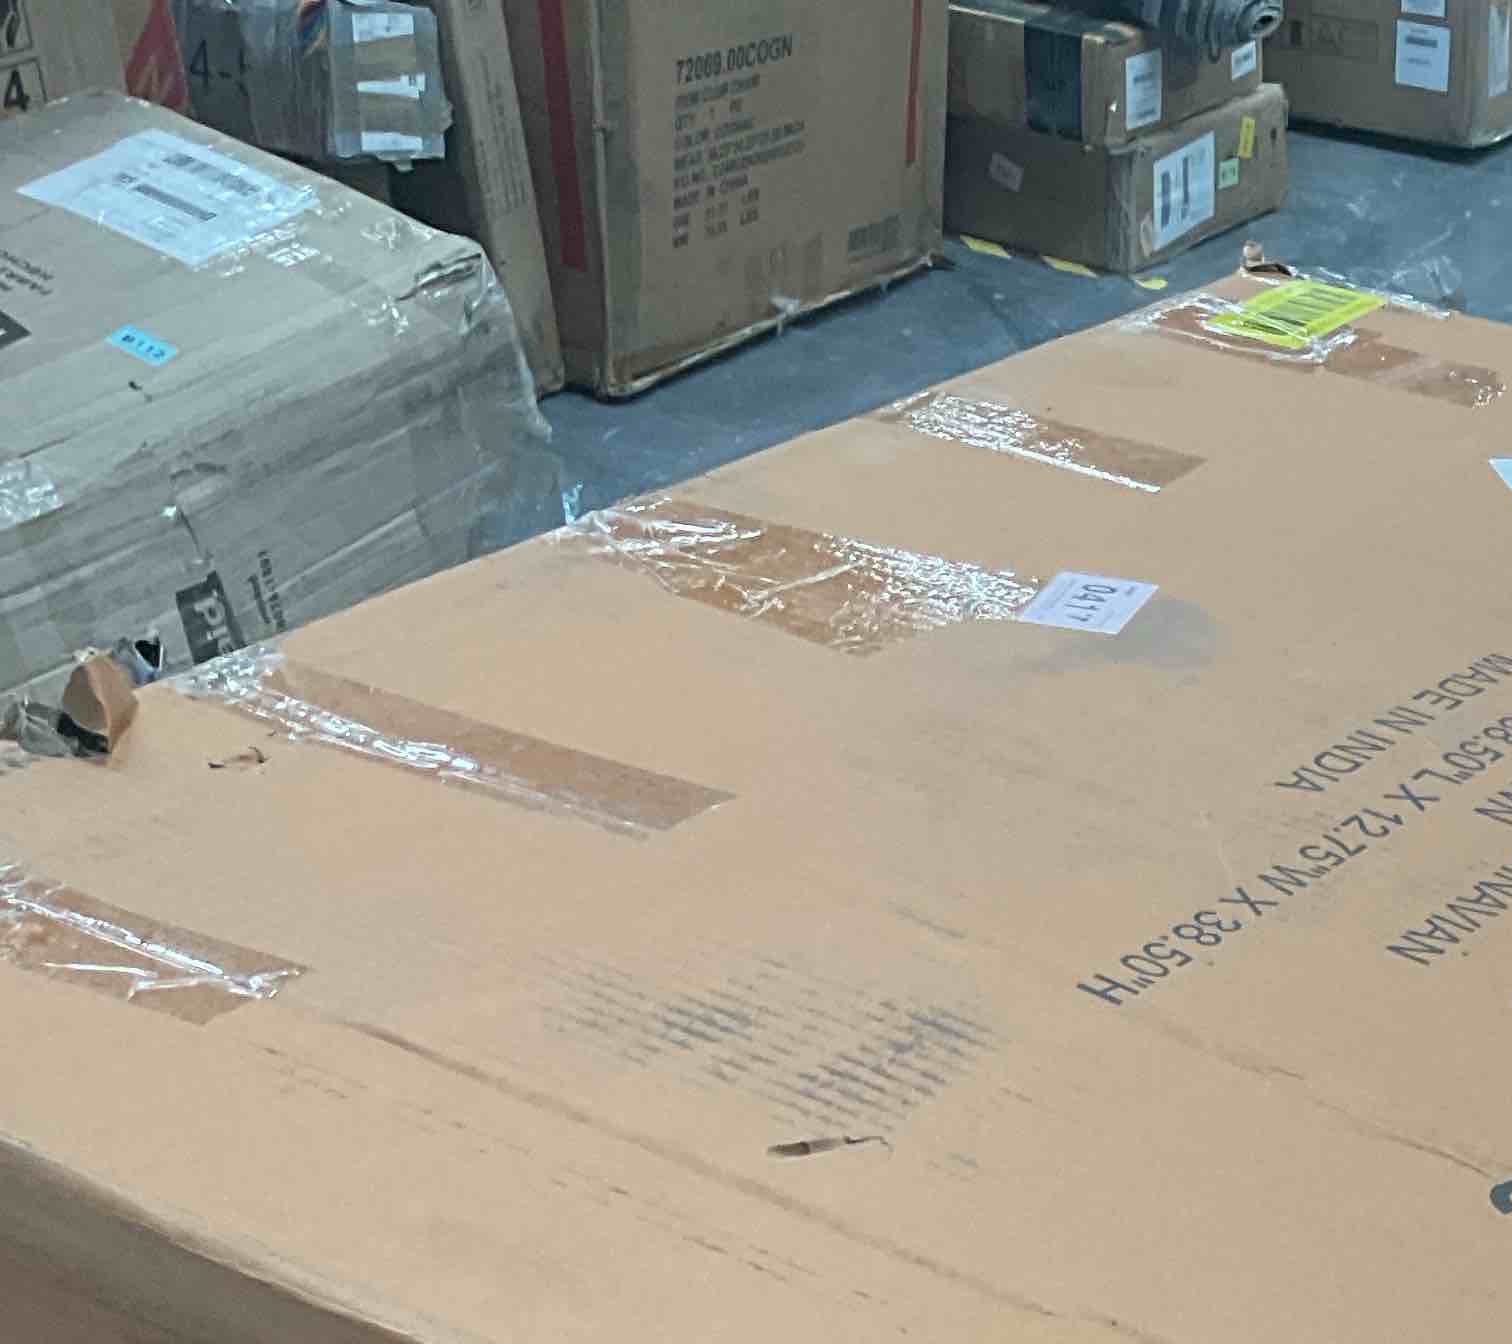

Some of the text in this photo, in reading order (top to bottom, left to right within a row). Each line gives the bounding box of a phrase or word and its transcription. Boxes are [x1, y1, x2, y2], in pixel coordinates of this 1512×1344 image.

[1373, 705, 1437, 735] IN
[1274, 729, 1397, 792] INDIA
[1383, 783, 1441, 812] X
[1257, 808, 1405, 896] 12.75"W
[1218, 886, 1279, 916] X
[1076, 910, 1242, 1006] 38.50"H
